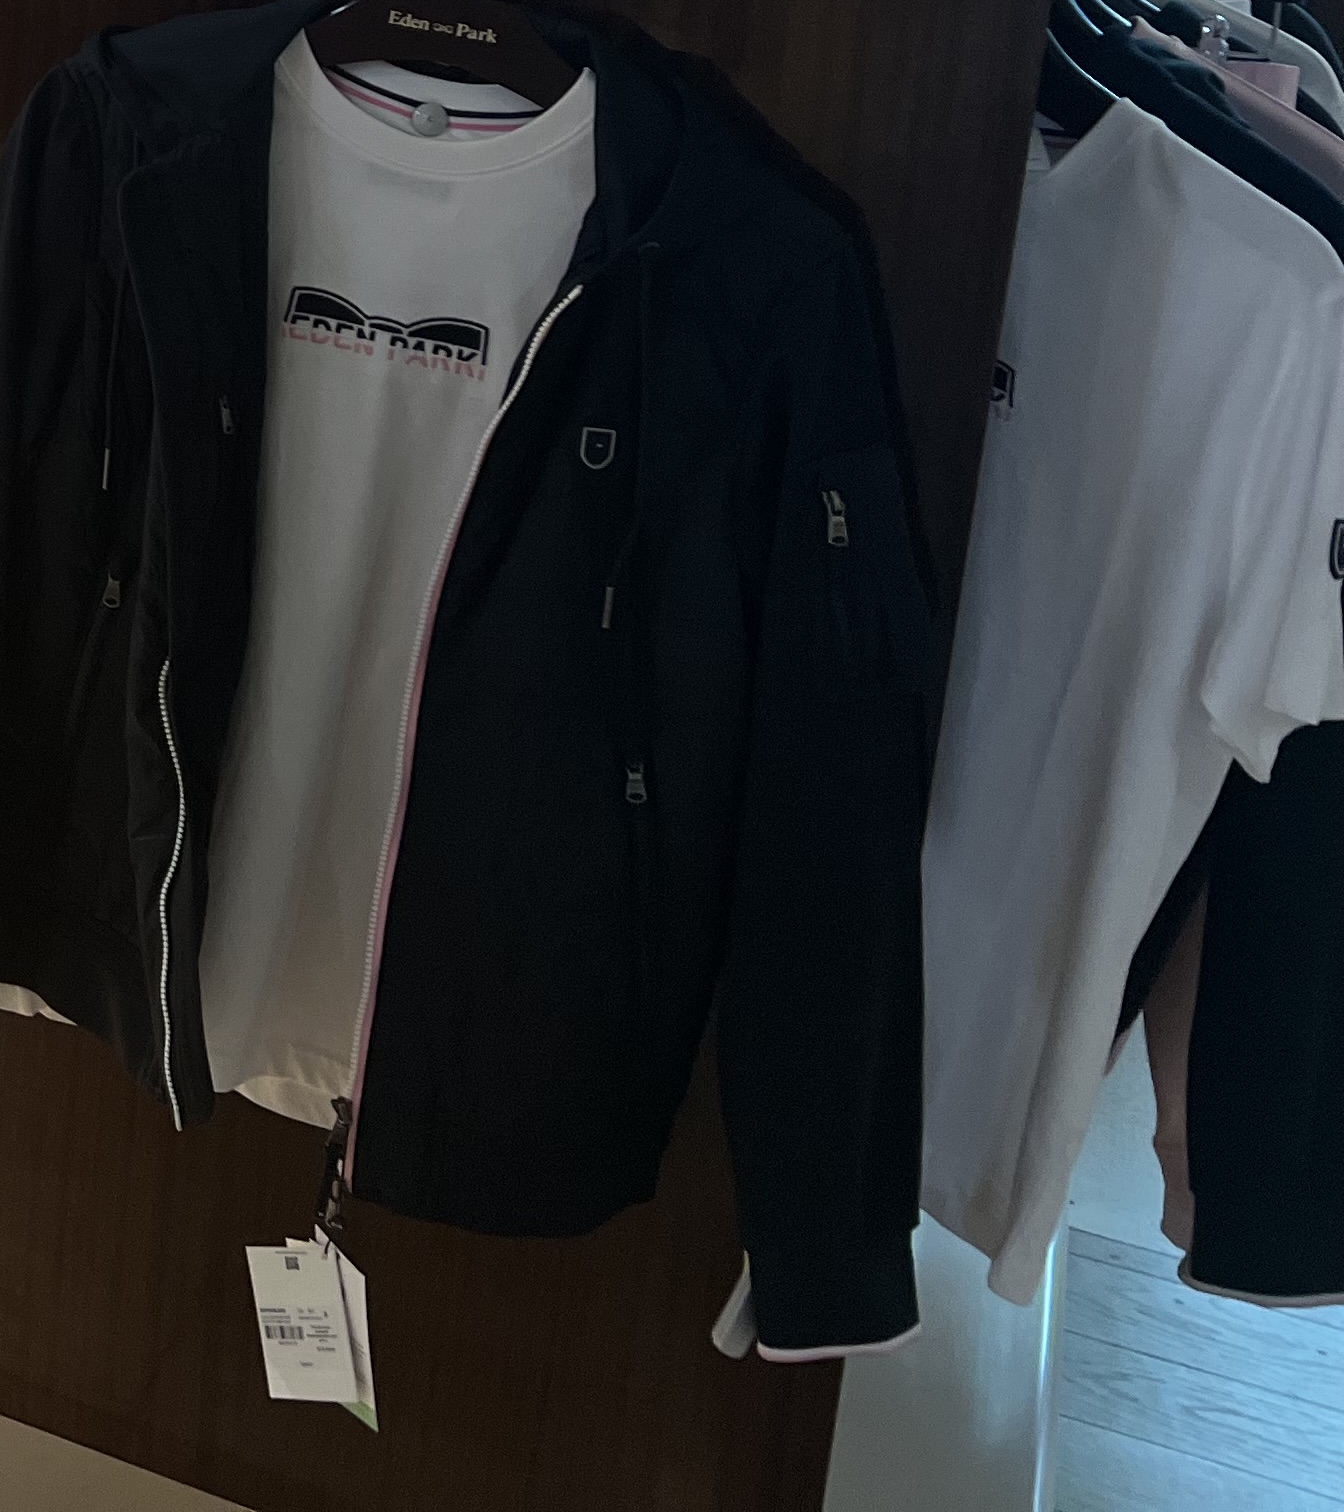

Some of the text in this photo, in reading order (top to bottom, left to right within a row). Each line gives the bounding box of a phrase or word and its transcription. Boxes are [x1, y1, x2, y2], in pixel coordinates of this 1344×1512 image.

[387, 9, 498, 44] Eden Park
[288, 313, 481, 379] EDEN PARK
